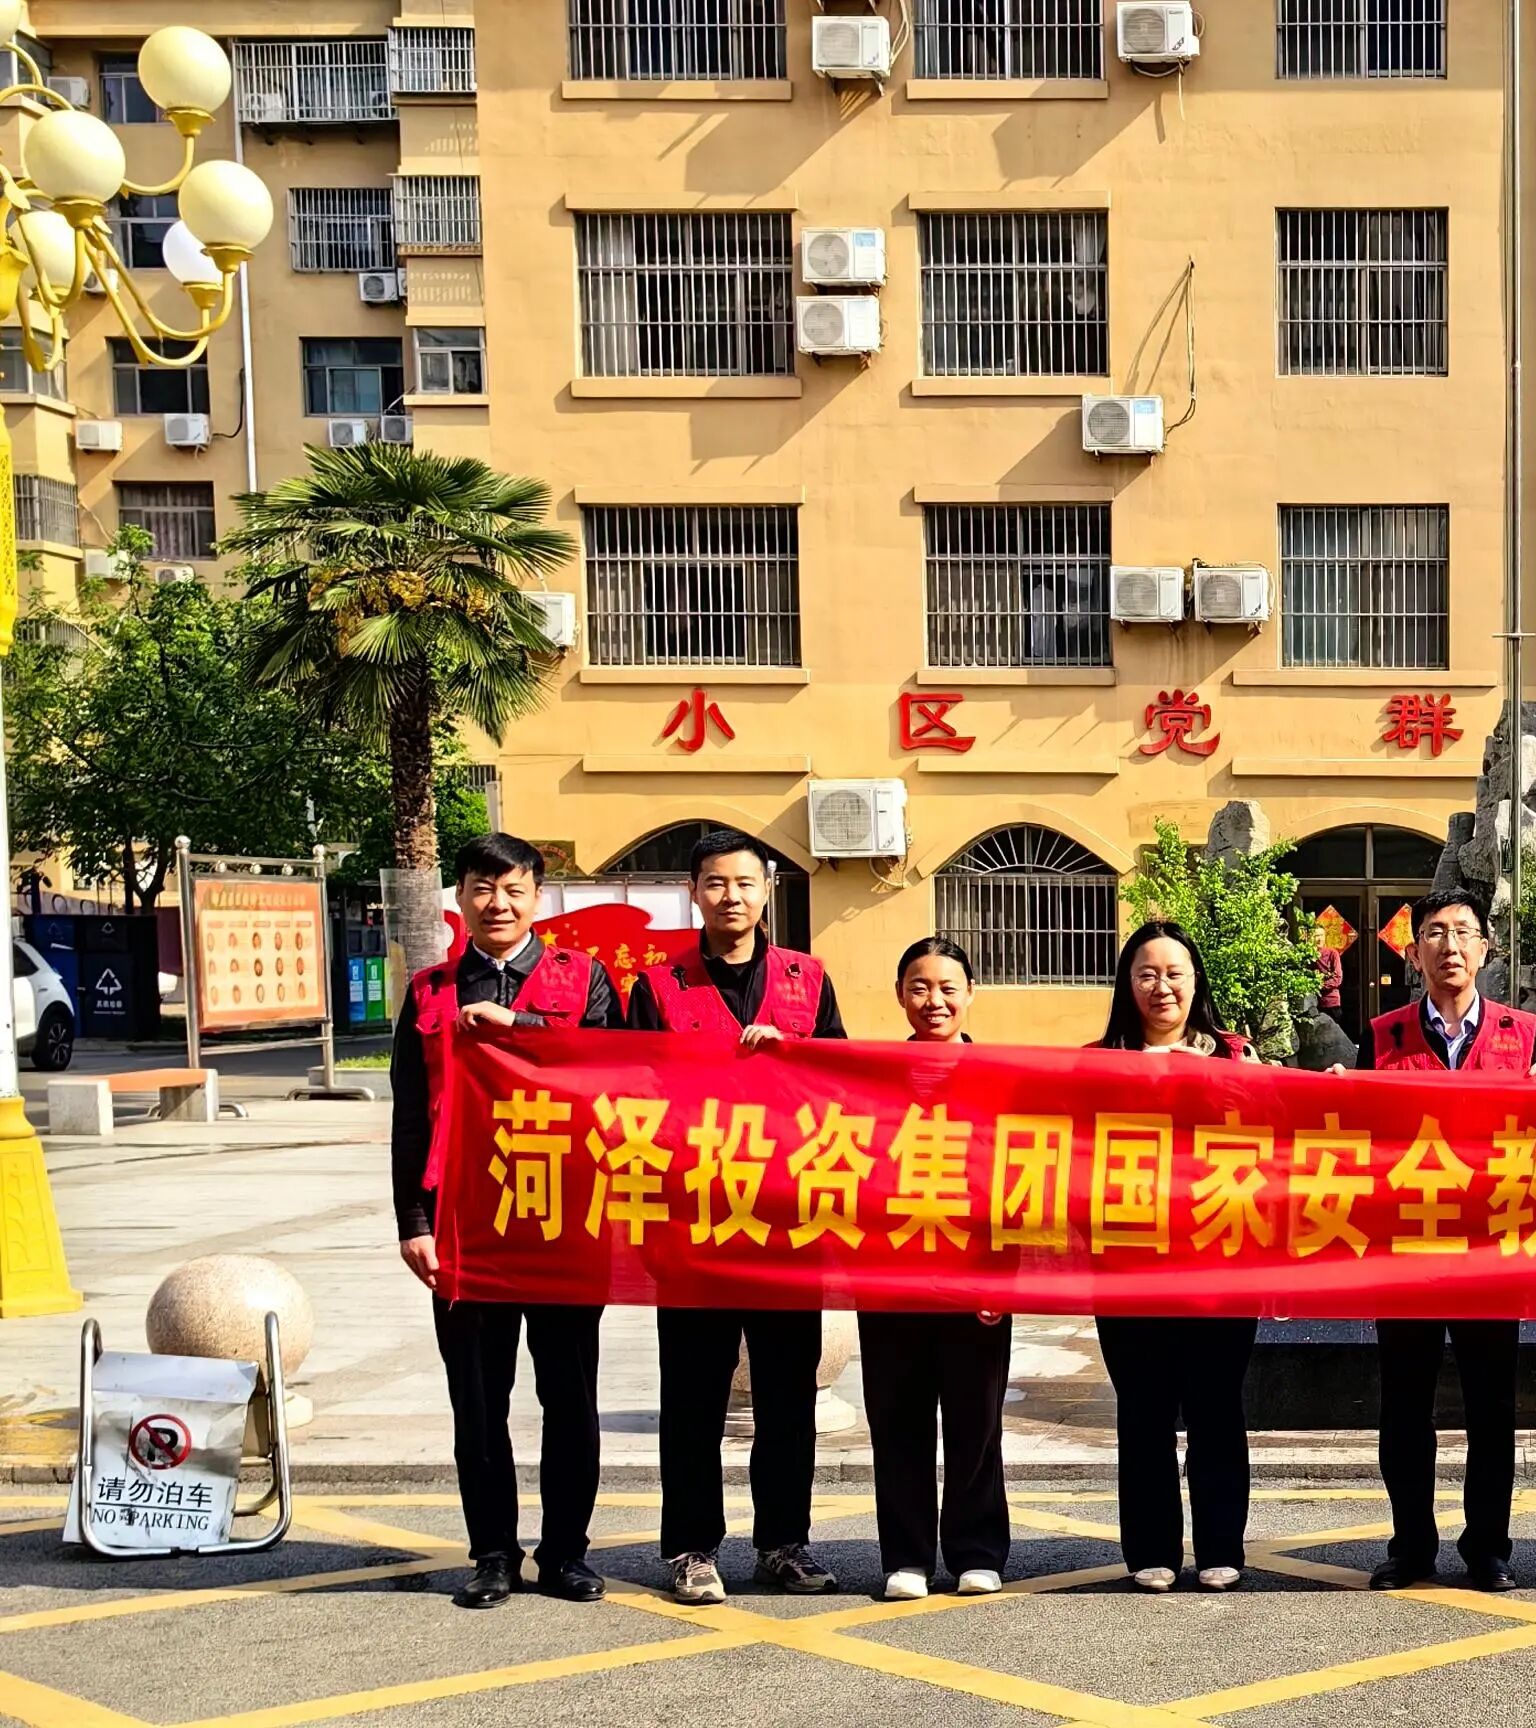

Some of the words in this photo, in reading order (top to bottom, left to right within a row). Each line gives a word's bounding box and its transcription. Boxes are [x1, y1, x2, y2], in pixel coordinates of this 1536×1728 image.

[98, 1476, 213, 1507] 请勿泊车
[92, 1508, 116, 1524] NO
